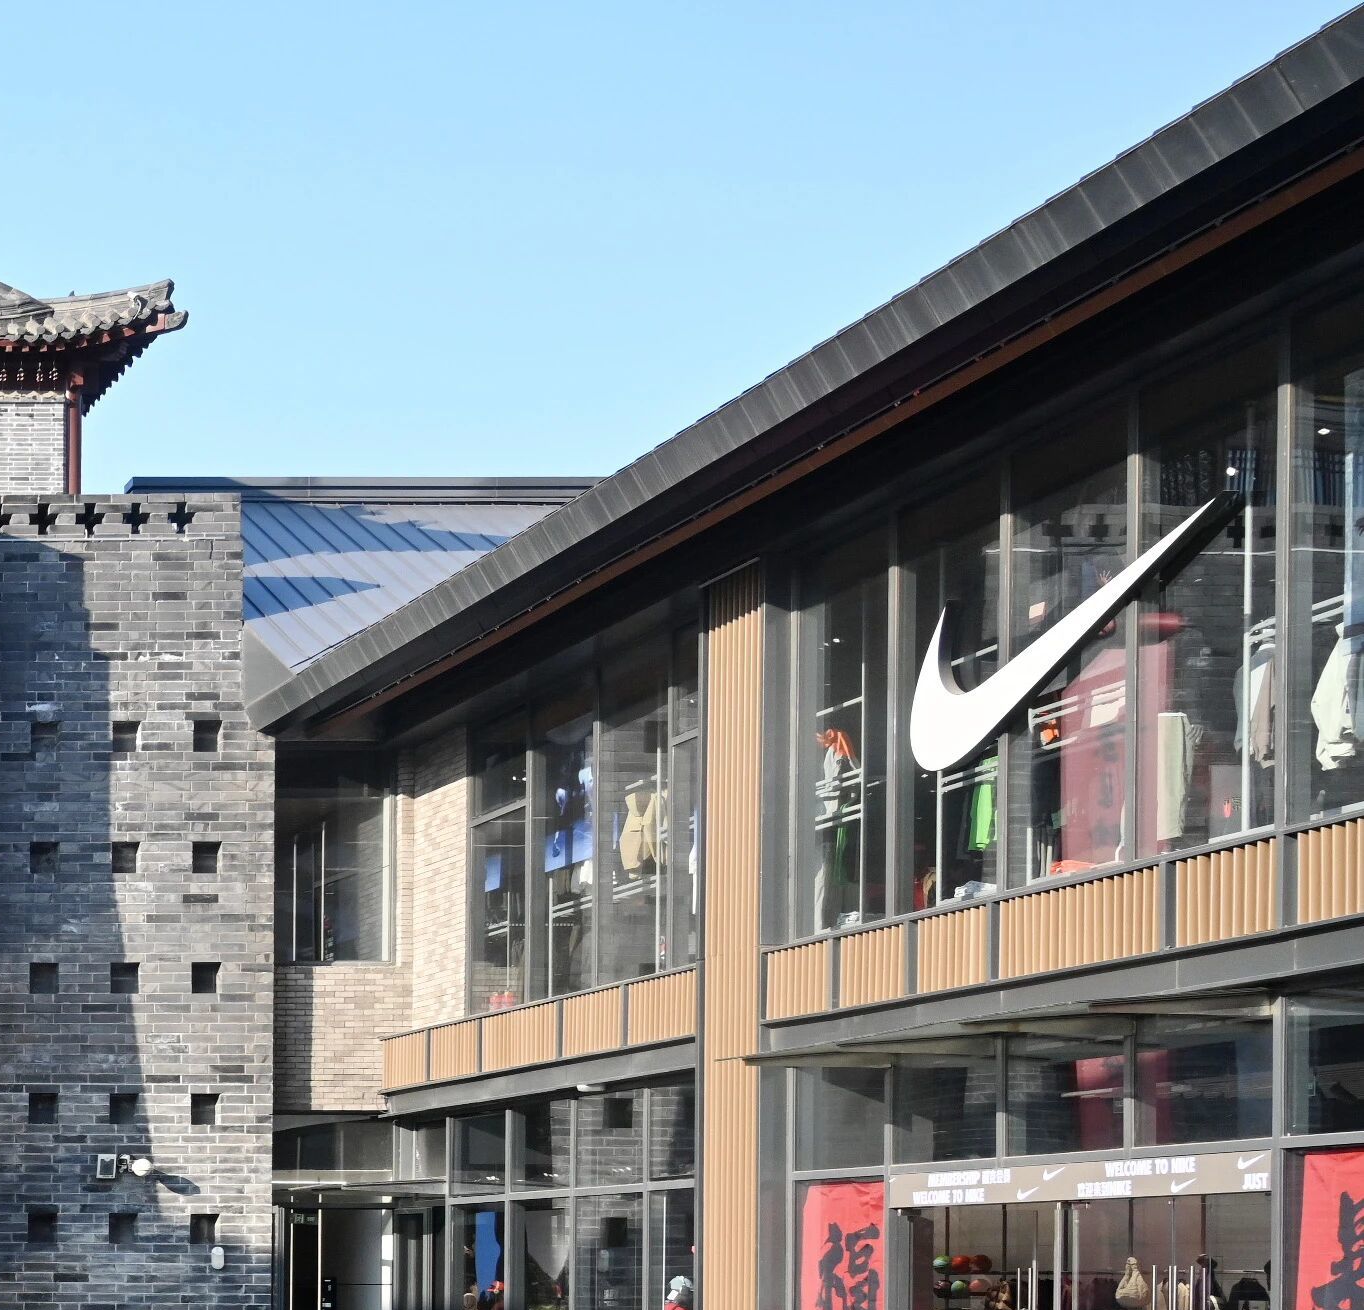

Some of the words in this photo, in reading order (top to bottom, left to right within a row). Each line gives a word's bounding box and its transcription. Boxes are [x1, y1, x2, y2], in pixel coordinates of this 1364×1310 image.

[1105, 1159, 1152, 1177] WELCOME
[1155, 1158, 1168, 1175] TO
[1171, 1156, 1196, 1173] NIKE
[928, 1171, 980, 1188] MEMBERSHIP
[1242, 1172, 1270, 1190] JUST
[912, 1190, 951, 1205] WELCOME
[952, 1189, 963, 1203] TO
[965, 1187, 985, 1202] NIKE
